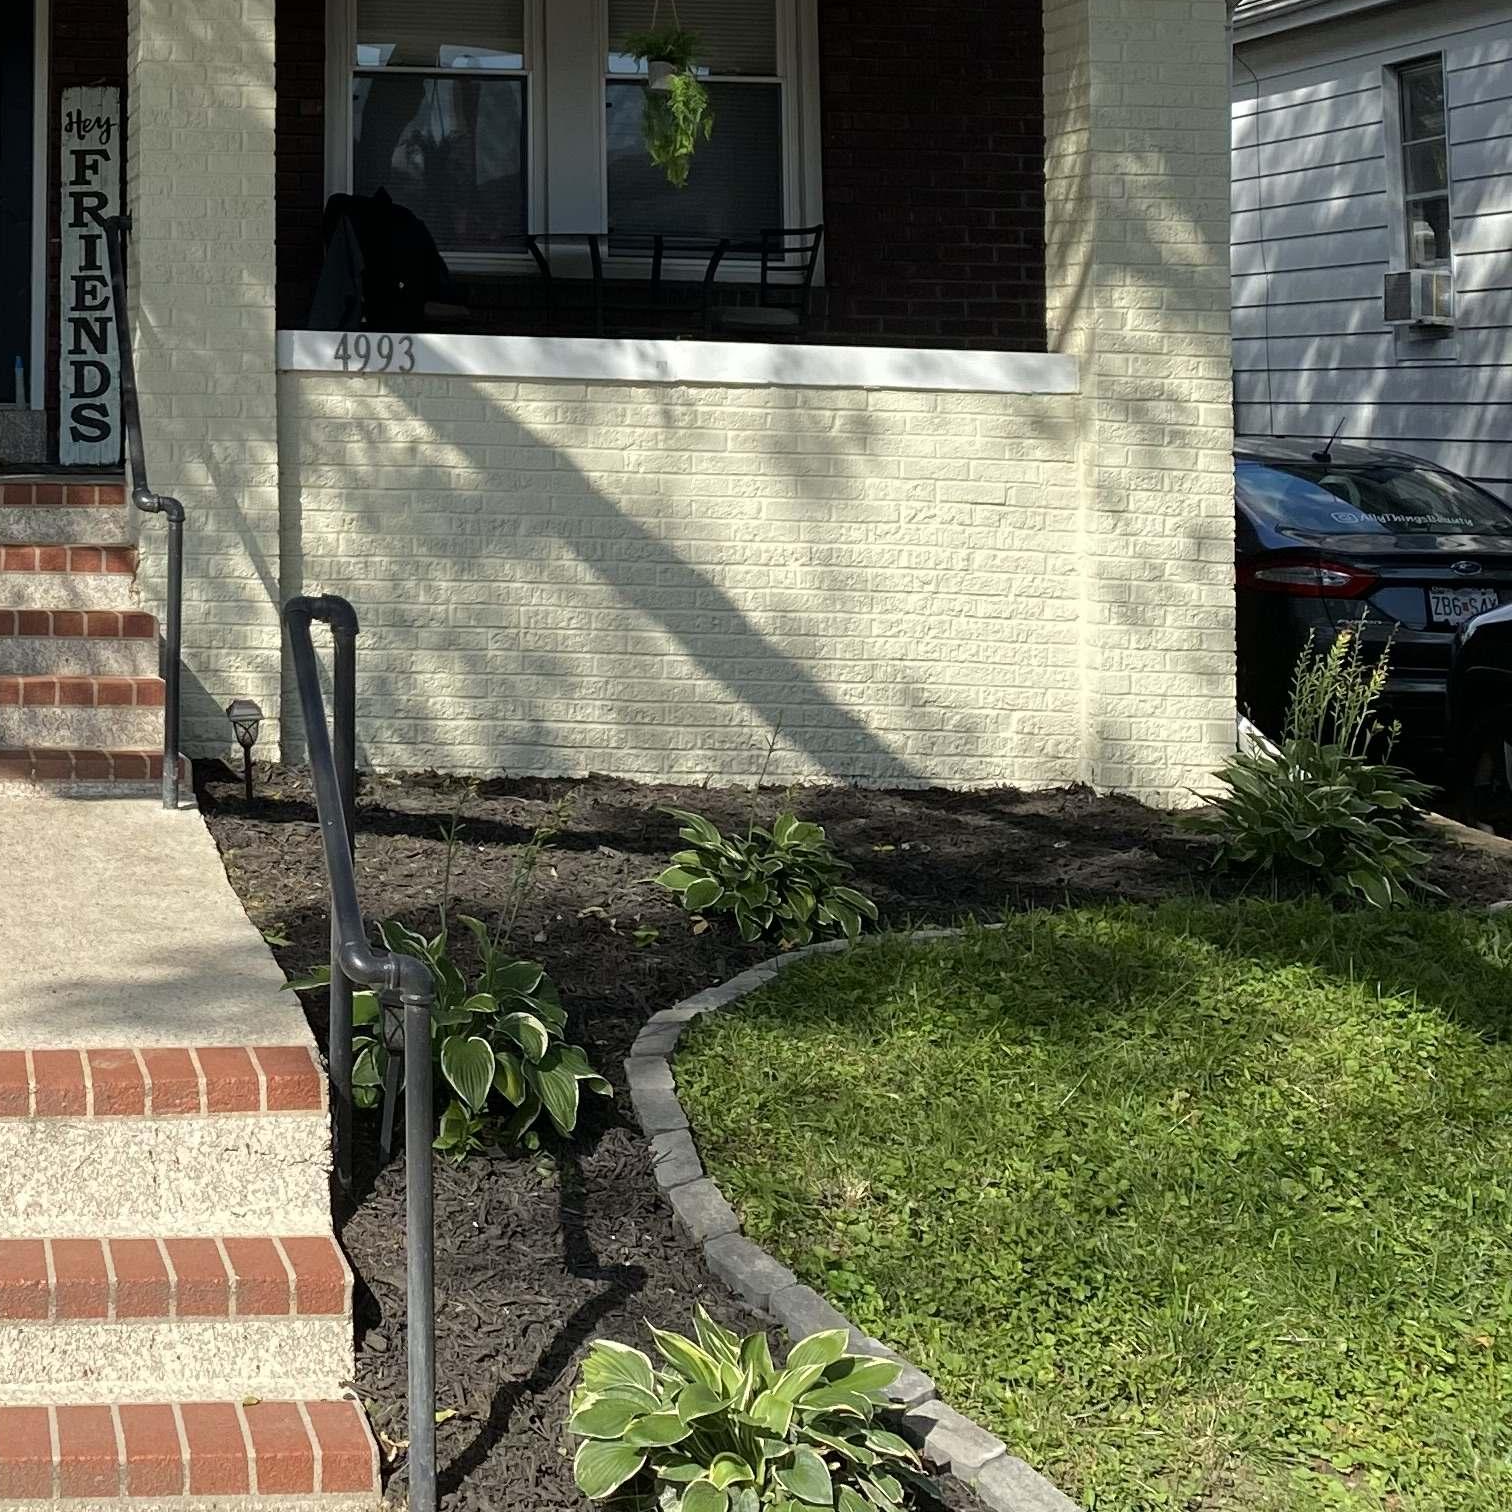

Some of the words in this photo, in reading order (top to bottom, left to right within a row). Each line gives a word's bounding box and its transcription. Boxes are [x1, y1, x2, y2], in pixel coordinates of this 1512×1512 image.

[64, 108, 117, 145] Hey
[68, 149, 113, 444] FRIENDS
[334, 333, 416, 373] 4993
[1432, 596, 1462, 616] ZB6
